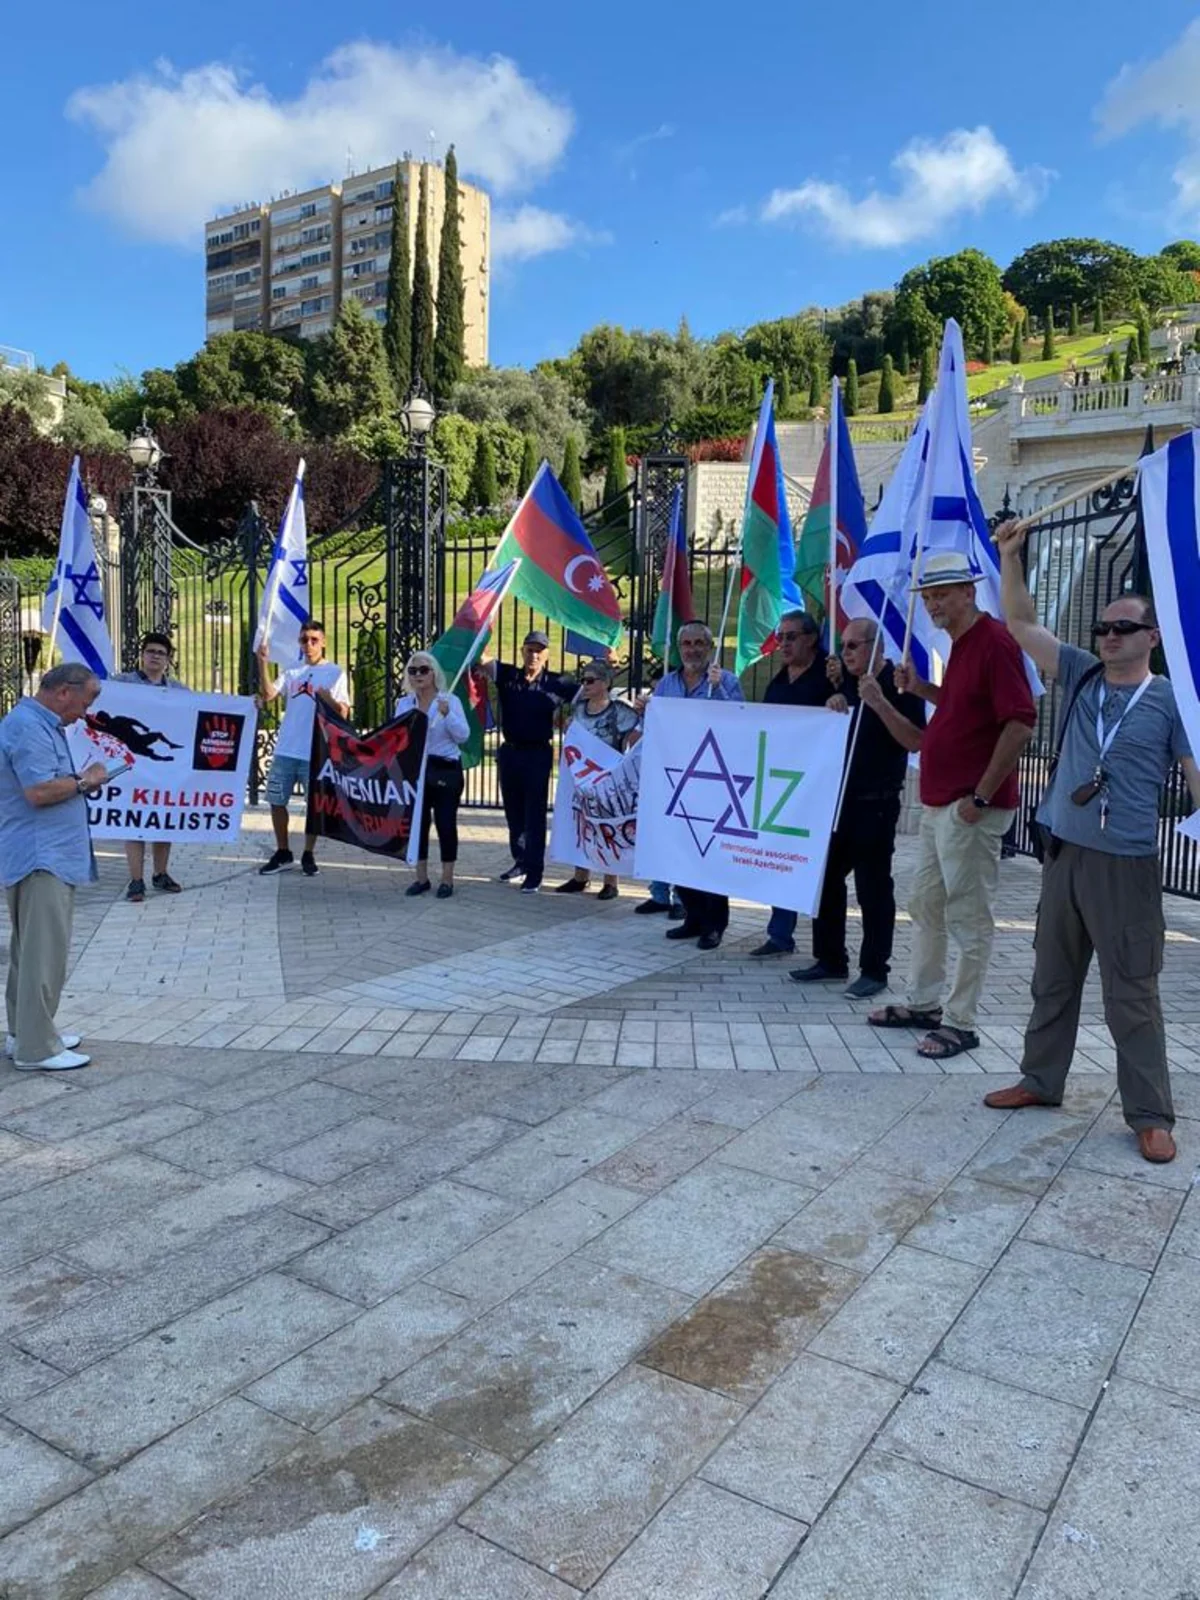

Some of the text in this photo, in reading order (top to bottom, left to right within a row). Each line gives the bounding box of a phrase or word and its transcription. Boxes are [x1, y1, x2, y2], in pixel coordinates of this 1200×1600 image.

[83, 785, 235, 808] OP KILLING
[87, 806, 231, 831] URNALISTS
[720, 841, 809, 864] International association
